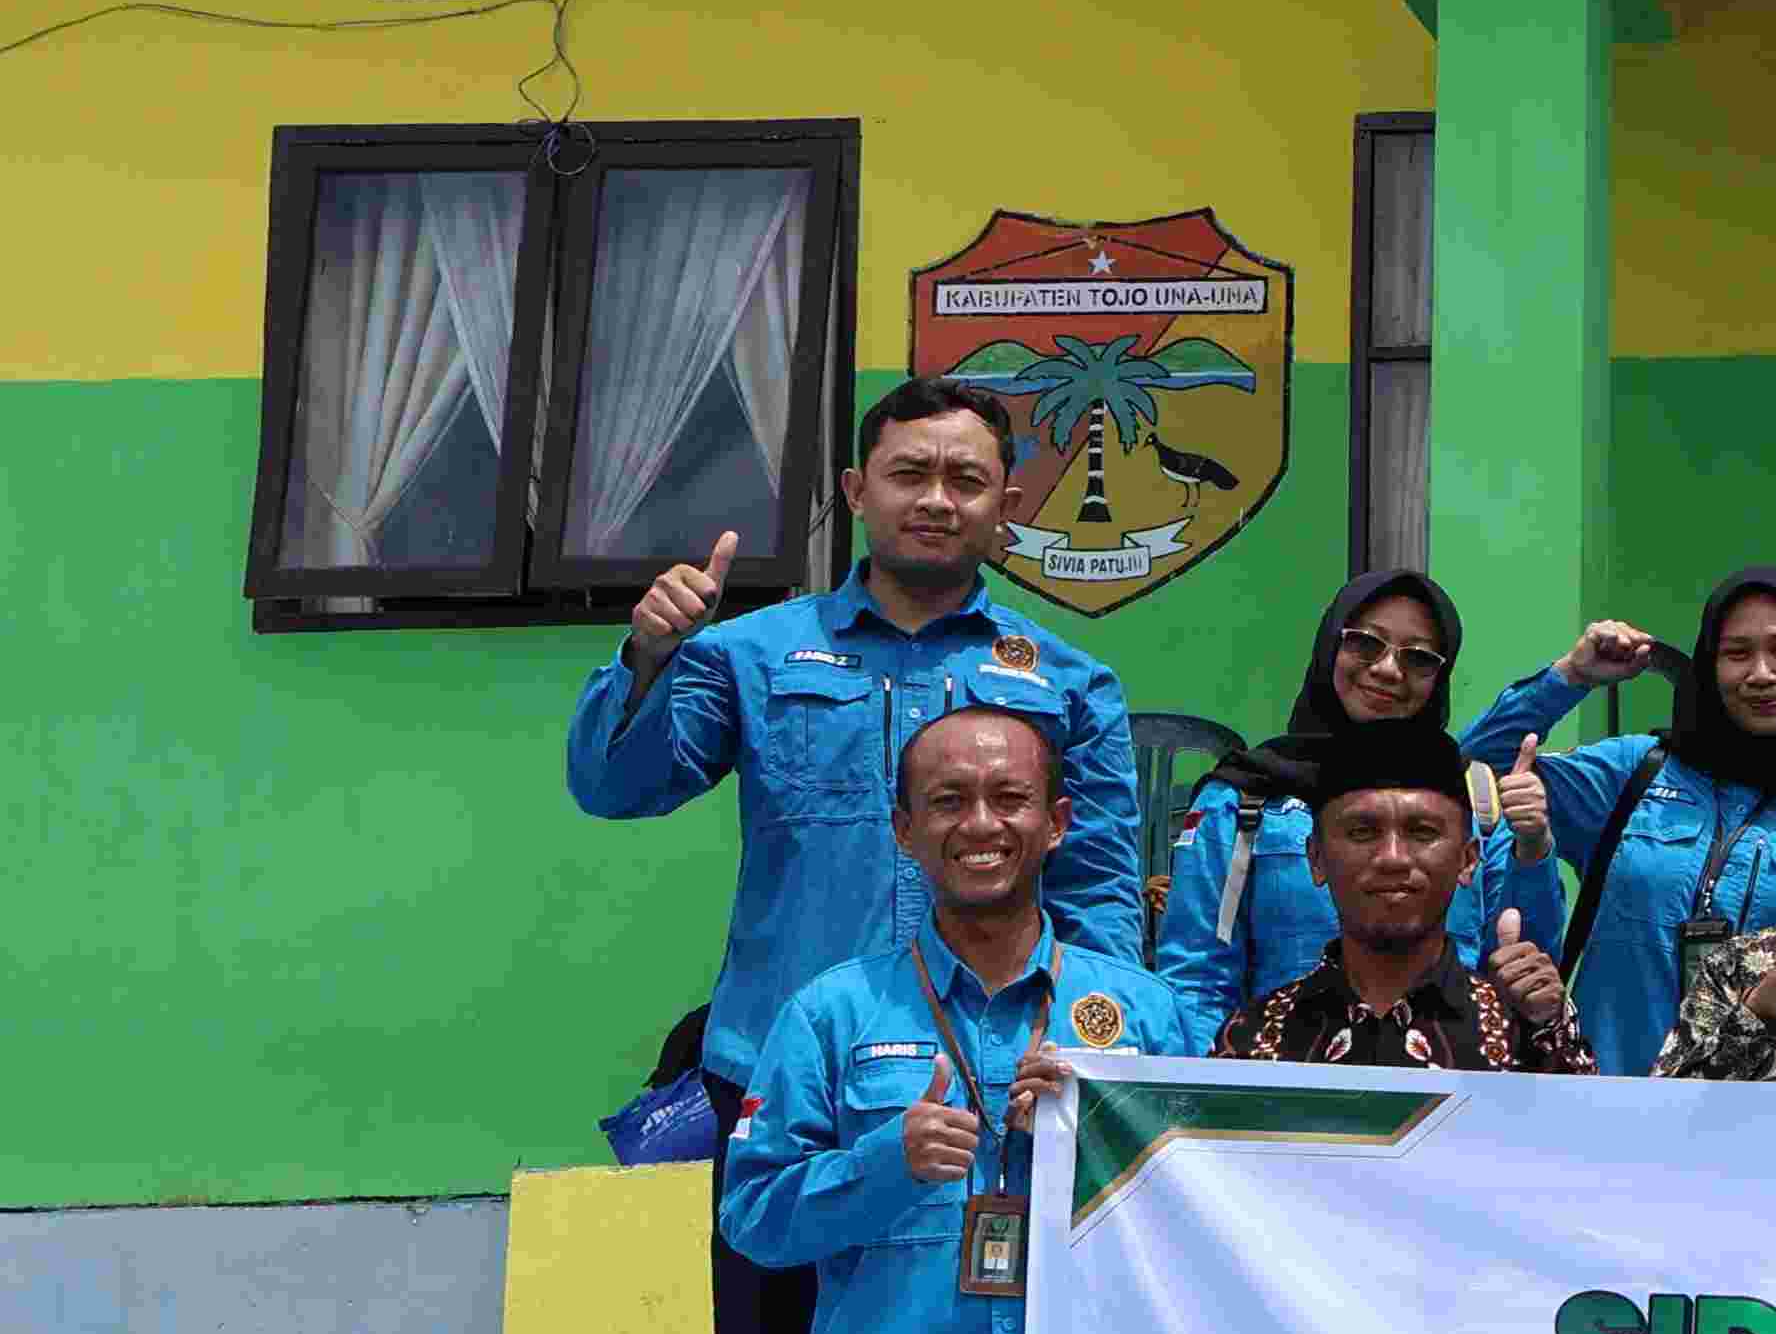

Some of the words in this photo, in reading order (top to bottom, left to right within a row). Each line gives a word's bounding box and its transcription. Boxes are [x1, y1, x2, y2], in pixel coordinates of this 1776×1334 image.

[944, 288, 1081, 309] KABUPATEN
[1088, 287, 1148, 307] TOJO
[1048, 554, 1085, 573] SIVIA
